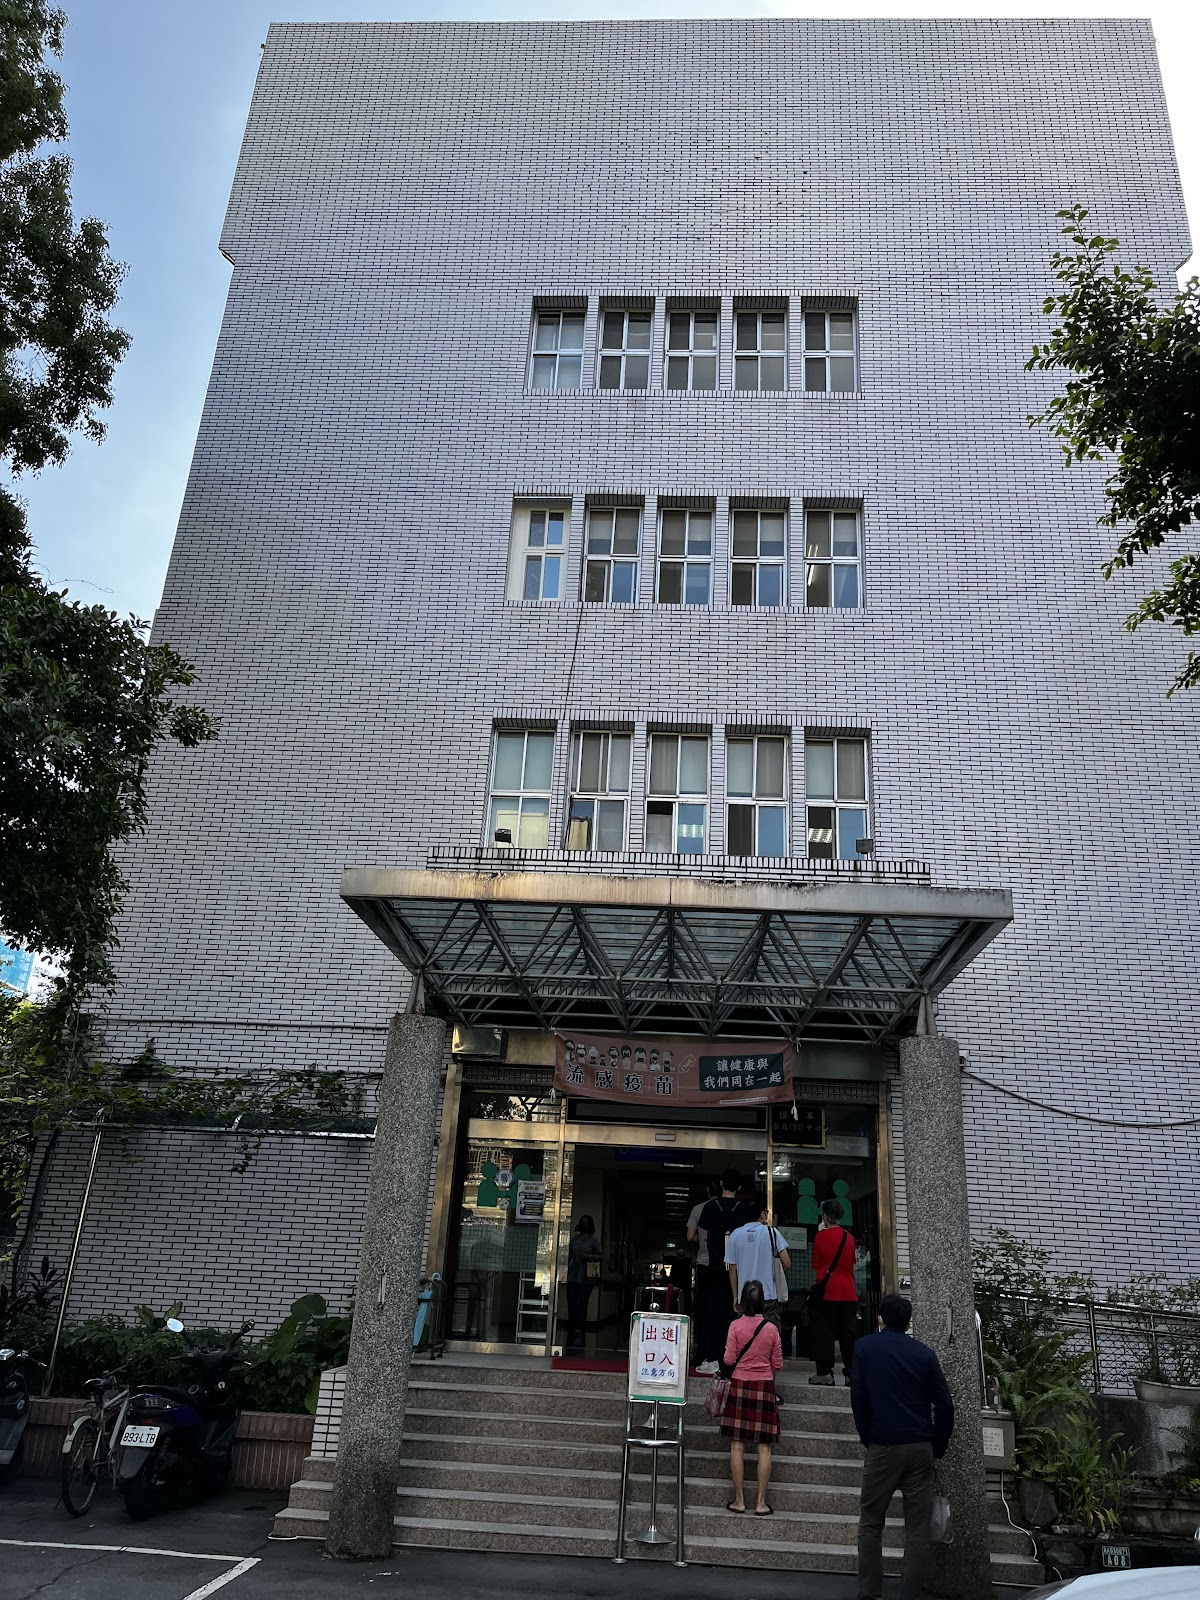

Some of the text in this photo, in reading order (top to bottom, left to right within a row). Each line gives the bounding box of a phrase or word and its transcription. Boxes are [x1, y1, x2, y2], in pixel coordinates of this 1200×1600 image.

[716, 1058, 769, 1072] 讓健康與
[566, 1061, 674, 1096] 流感疫苗
[703, 1071, 782, 1089] 我們同在一起
[641, 1367, 675, 1378] 注意方向
